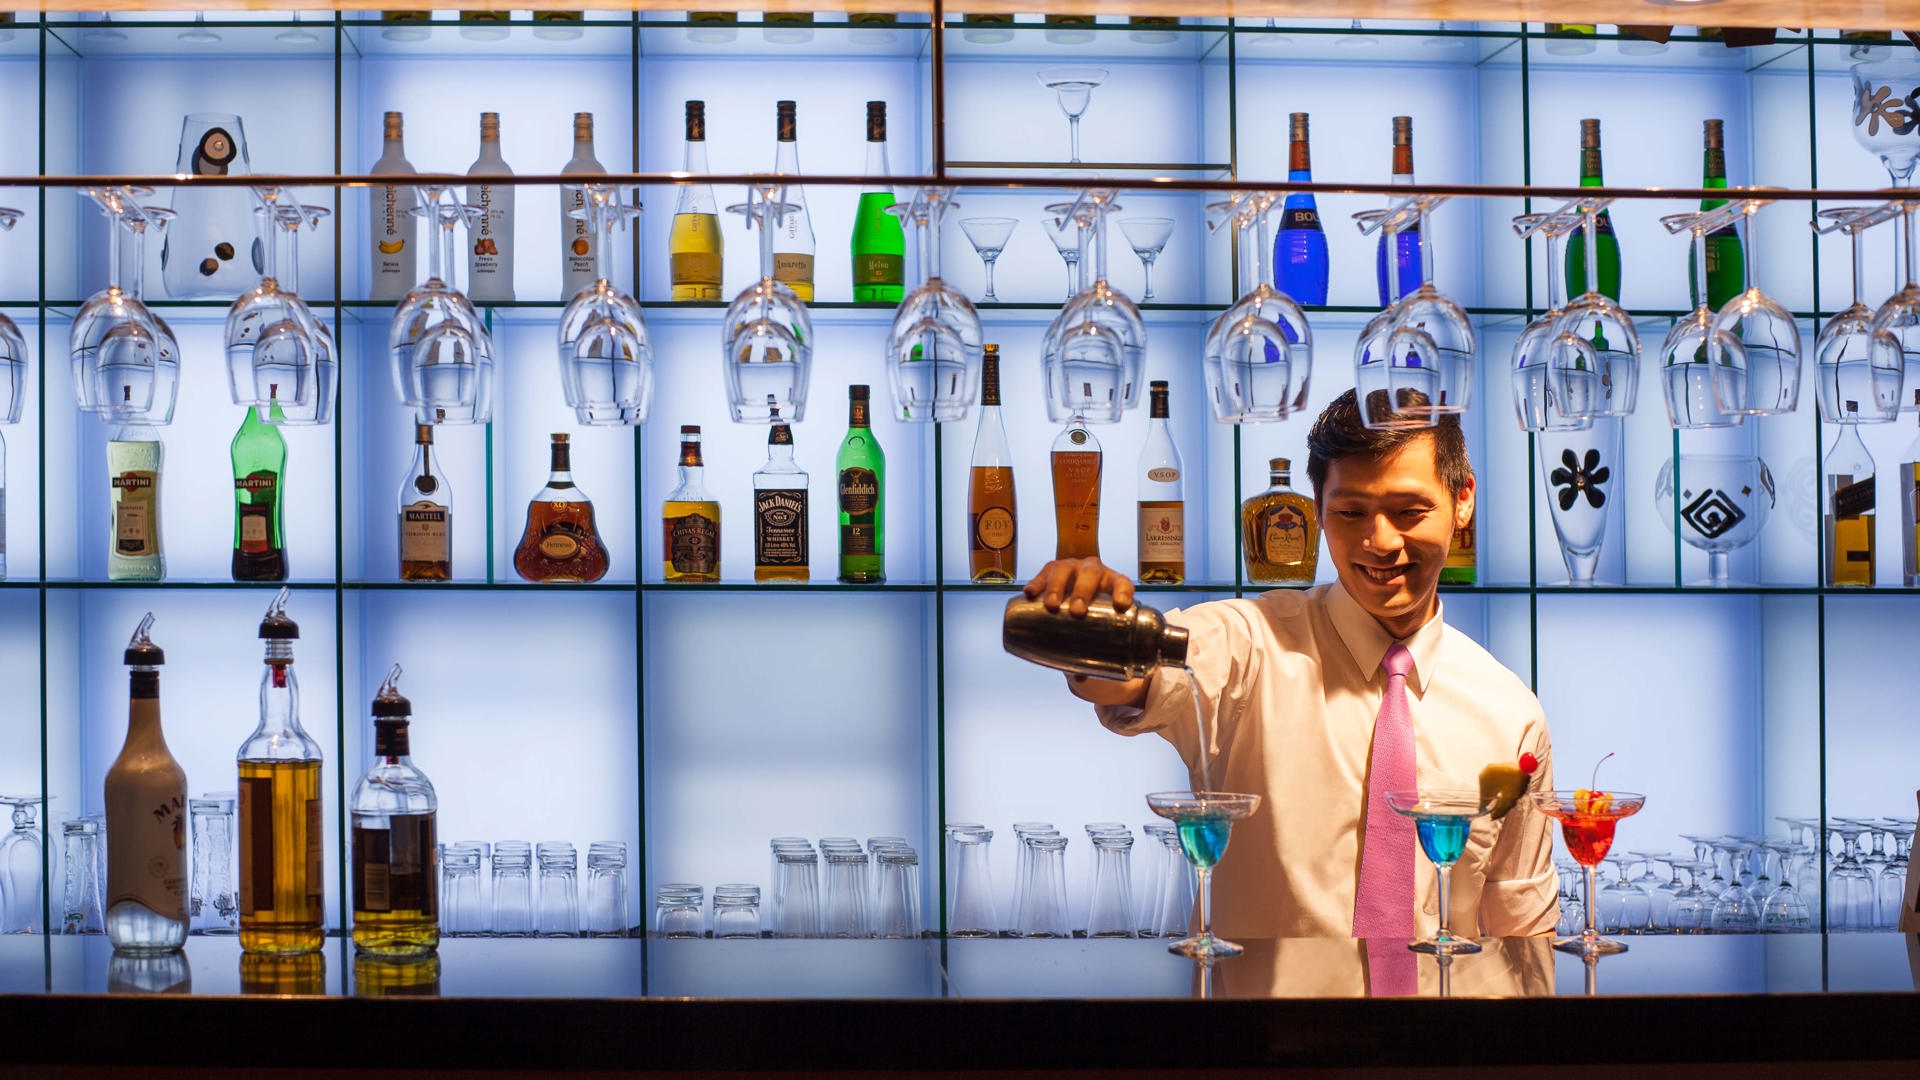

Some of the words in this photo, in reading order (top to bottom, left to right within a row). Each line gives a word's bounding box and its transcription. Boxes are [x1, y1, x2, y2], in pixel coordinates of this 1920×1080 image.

[385, 184, 397, 235] eichenné
[113, 478, 150, 487] MARTINI
[236, 479, 273, 488] MARTINI
[840, 482, 875, 495] Glenfiddich
[758, 498, 776, 513] JACK
[775, 495, 803, 513] DANIEL'S
[409, 512, 442, 521] MARTELL
[673, 527, 696, 537] CHIVAS
[852, 527, 861, 536] 12
